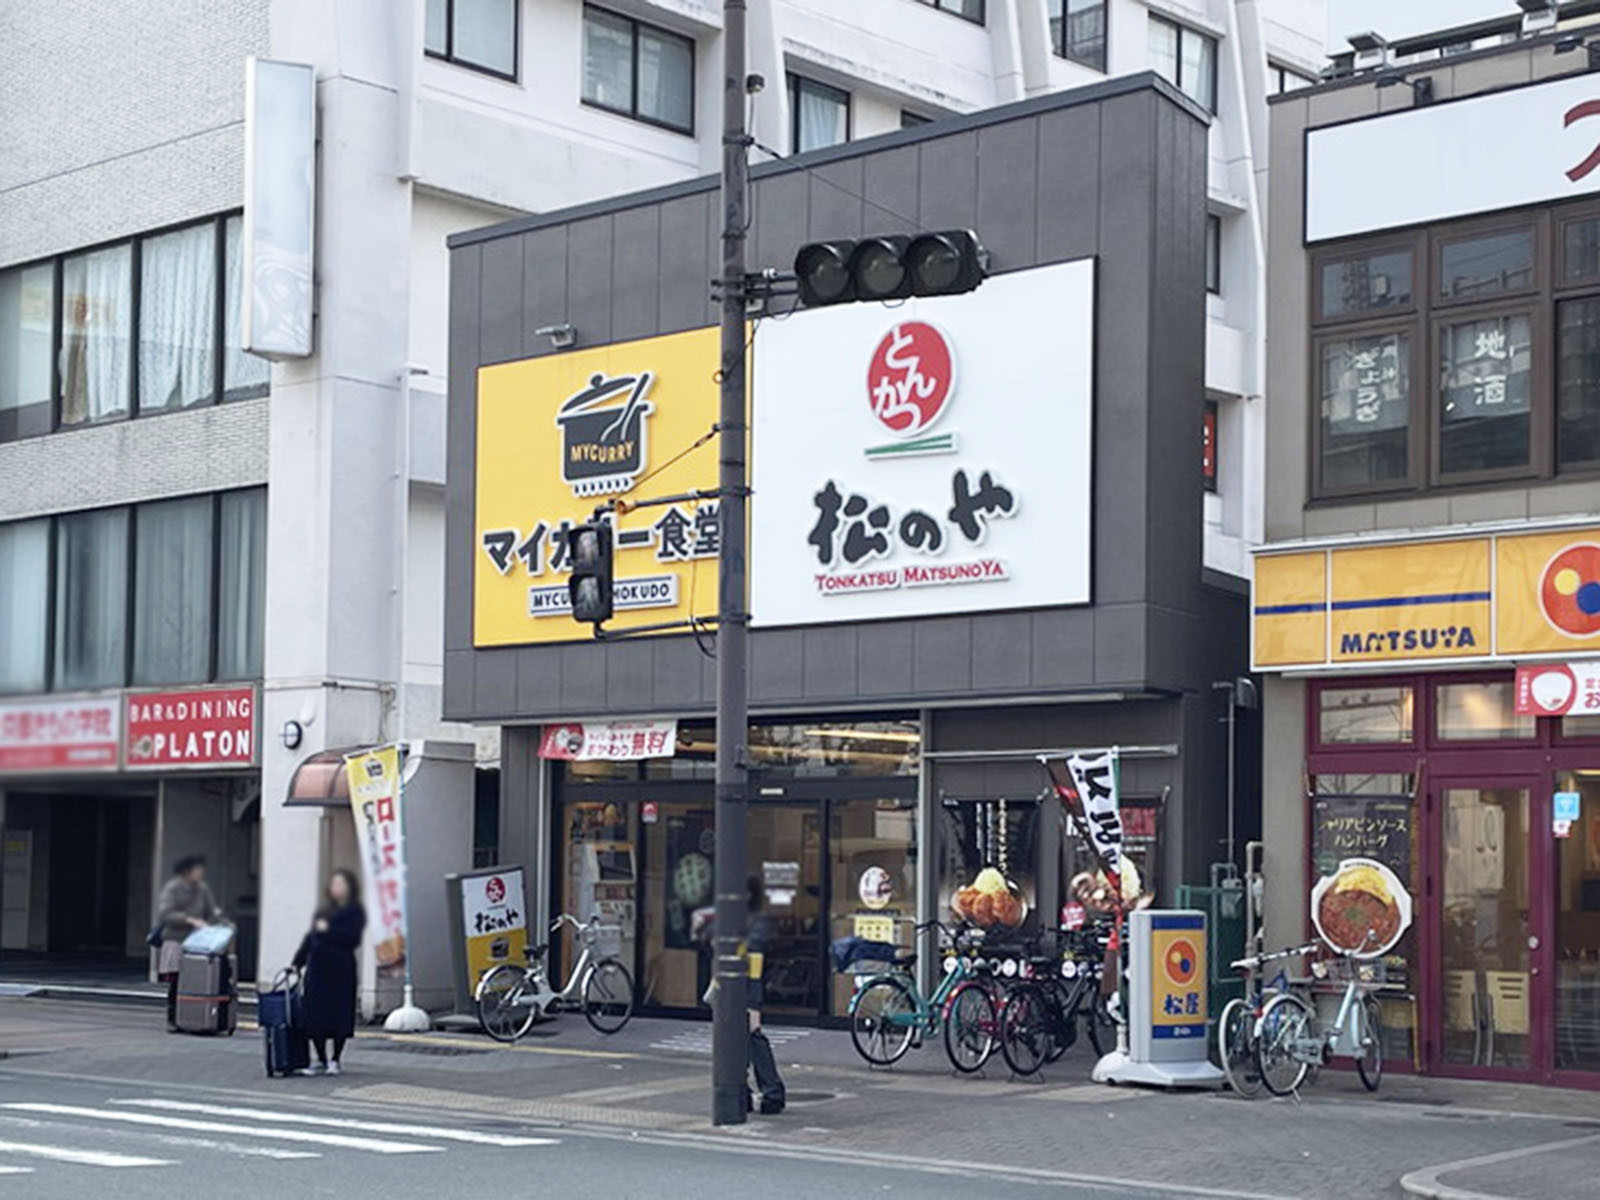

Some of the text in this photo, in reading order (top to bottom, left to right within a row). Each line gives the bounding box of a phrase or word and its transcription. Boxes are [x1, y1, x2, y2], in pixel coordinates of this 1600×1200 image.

[873, 324, 936, 429] とんかつ
[1473, 330, 1507, 405] 地酒
[571, 441, 634, 464] MYCURRY
[808, 470, 1013, 565] 松のや
[483, 504, 720, 574] マイカー食堂
[613, 582, 670, 602] HOKUDO
[815, 572, 897, 591] TONKATSU
[1340, 626, 1476, 654] MATSUYA
[131, 698, 250, 723] BAR&DINING
[154, 730, 250, 758] PLATON
[1163, 992, 1199, 1015] 松屋
